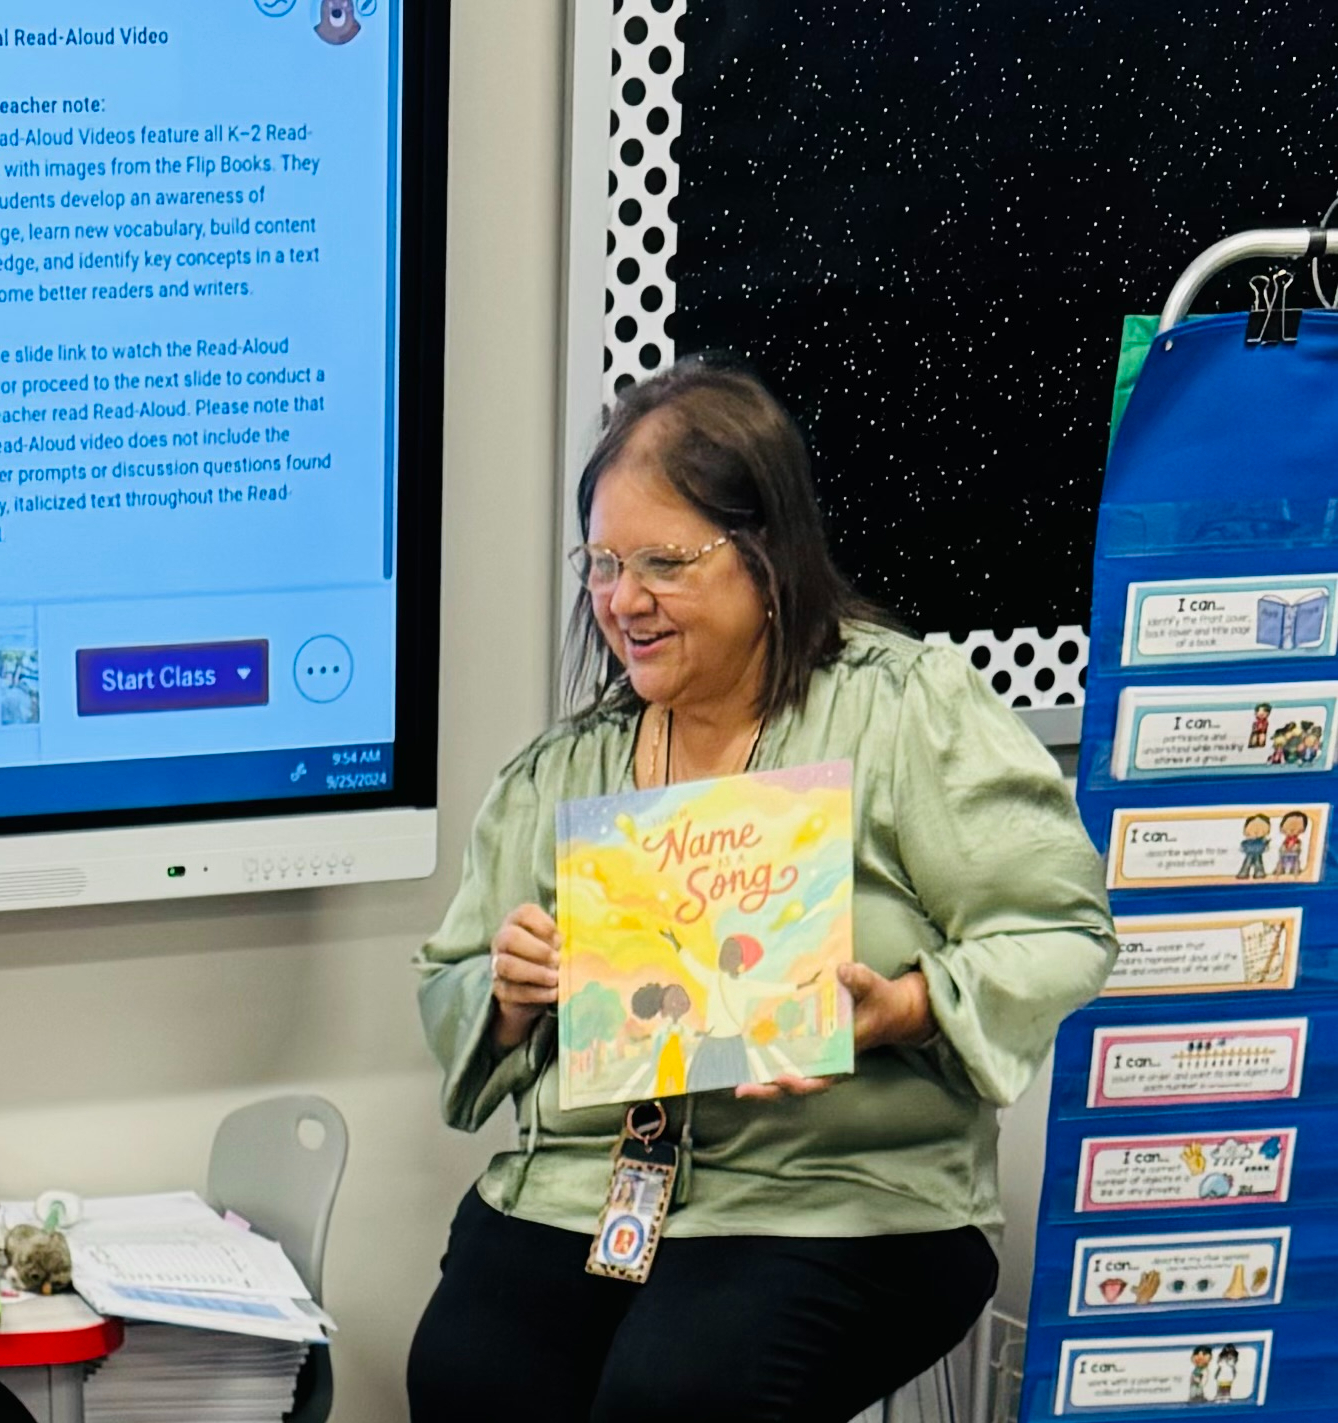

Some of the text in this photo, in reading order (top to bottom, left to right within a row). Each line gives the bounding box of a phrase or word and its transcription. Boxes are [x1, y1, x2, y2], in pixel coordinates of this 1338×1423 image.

[14, 26, 115, 47] Read-Aloud
[119, 25, 169, 46] Video
[62, 96, 106, 114] note:
[78, 127, 136, 146] Videos
[140, 125, 200, 145] feature
[203, 124, 223, 143] all
[3, 159, 41, 178] with
[44, 159, 106, 182] images
[110, 156, 151, 177] from
[155, 156, 182, 175] the
[186, 155, 216, 178] Flip
[280, 153, 321, 177] They
[60, 189, 126, 212] develop
[129, 191, 151, 207] an
[155, 189, 244, 206] awareness
[248, 184, 266, 204] of
[28, 222, 71, 241] learn
[74, 225, 109, 240] new
[113, 218, 206, 241] vocabulary,
[210, 217, 251, 236] build
[254, 217, 316, 235] content
[42, 251, 75, 271] and
[78, 249, 140, 273] identify
[144, 249, 172, 273] key
[175, 249, 252, 270] concepts
[255, 248, 271, 265] in
[274, 249, 285, 264] a
[289, 247, 320, 264] text
[38, 283, 88, 302] better
[91, 281, 154, 300] readers
[158, 279, 190, 298] and
[193, 280, 253, 297] writers.
[15, 344, 54, 364] slide
[57, 343, 87, 362] link
[90, 344, 108, 361] to
[112, 341, 162, 360] watch
[166, 340, 192, 358] the
[196, 336, 289, 358] Read-Aloud
[0, 379, 18, 395] or
[21, 373, 89, 398] proceed
[93, 374, 110, 391] to
[113, 372, 141, 391] the
[144, 372, 179, 389] next
[183, 369, 222, 388] slide
[226, 369, 243, 386] to
[245, 366, 311, 386] conduct
[315, 368, 326, 383] a
[52, 403, 89, 422] read
[93, 399, 191, 420] Read-Aloud.
[195, 398, 250, 417] Please
[253, 397, 290, 414] note
[293, 395, 325, 413] that
[79, 432, 124, 451] video
[127, 431, 168, 449] does
[172, 430, 199, 447] not
[202, 426, 261, 446] include
[264, 425, 290, 444] the
[18, 463, 87, 487] prompts
[90, 465, 108, 479] or
[111, 459, 200, 479] discussion
[202, 457, 282, 478] questions
[286, 452, 332, 471] found
[13, 492, 87, 513] italicized
[90, 492, 121, 509] text
[125, 488, 214, 510] throughout
[218, 487, 243, 504] the
[1178, 598, 1186, 612] I
[102, 664, 217, 692] Start Class
[1173, 717, 1182, 730] I
[359, 748, 382, 763] AM
[325, 771, 387, 790] 9/25/2024
[642, 820, 763, 873] Name
[1130, 829, 1138, 843] I
[674, 862, 799, 925] Song
[1113, 1055, 1122, 1069] I
[1122, 1151, 1130, 1165] I
[1093, 1259, 1102, 1273] I
[1078, 1361, 1087, 1374] I
